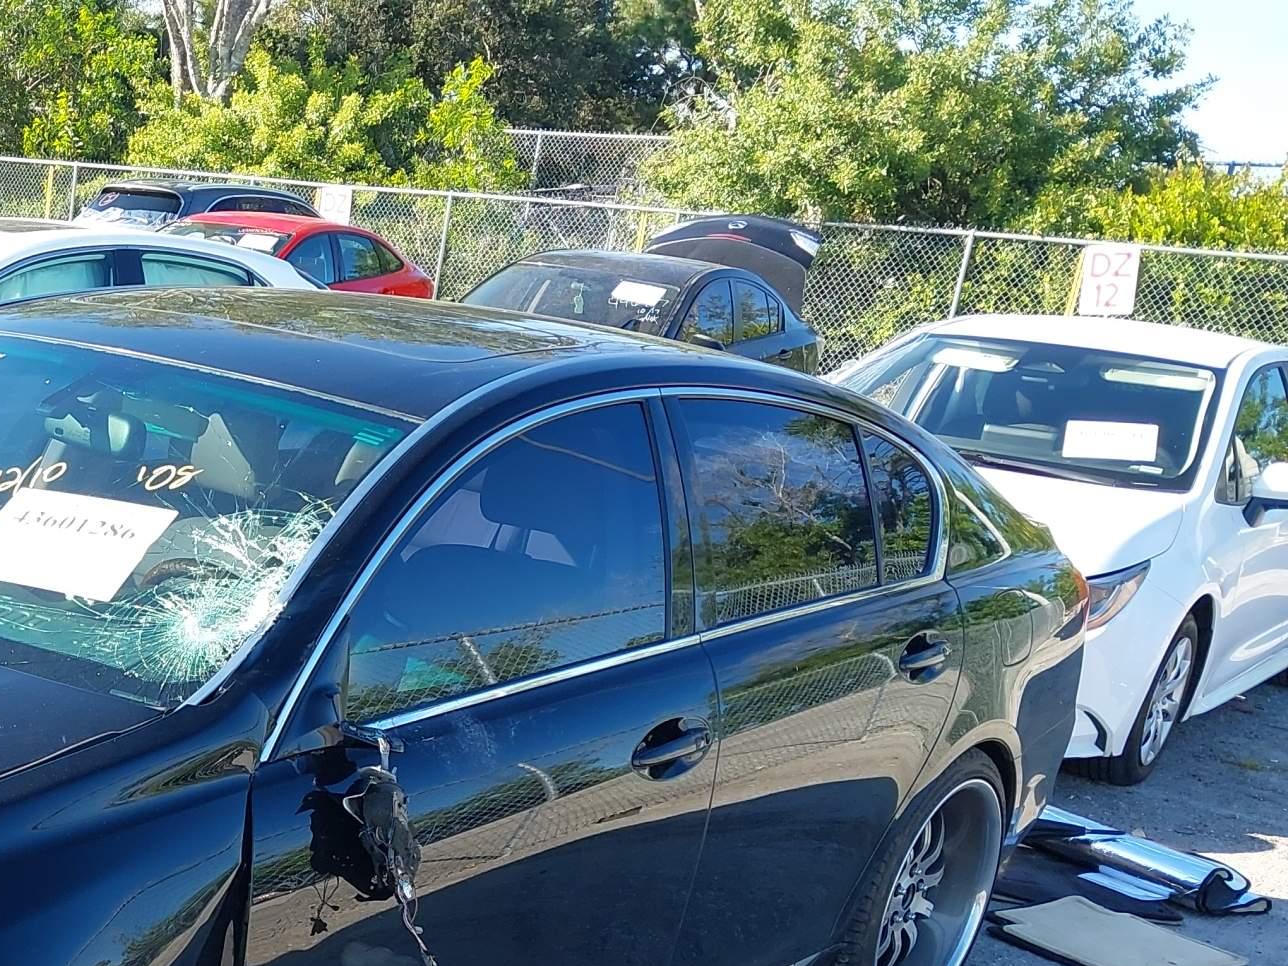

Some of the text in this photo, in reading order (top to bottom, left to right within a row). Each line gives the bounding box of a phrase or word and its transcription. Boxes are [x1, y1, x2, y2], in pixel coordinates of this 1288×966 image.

[323, 192, 347, 214] DZ
[1091, 252, 1133, 277] DZ
[1095, 283, 1119, 308] 12
[13, 510, 136, 539] 43601286
